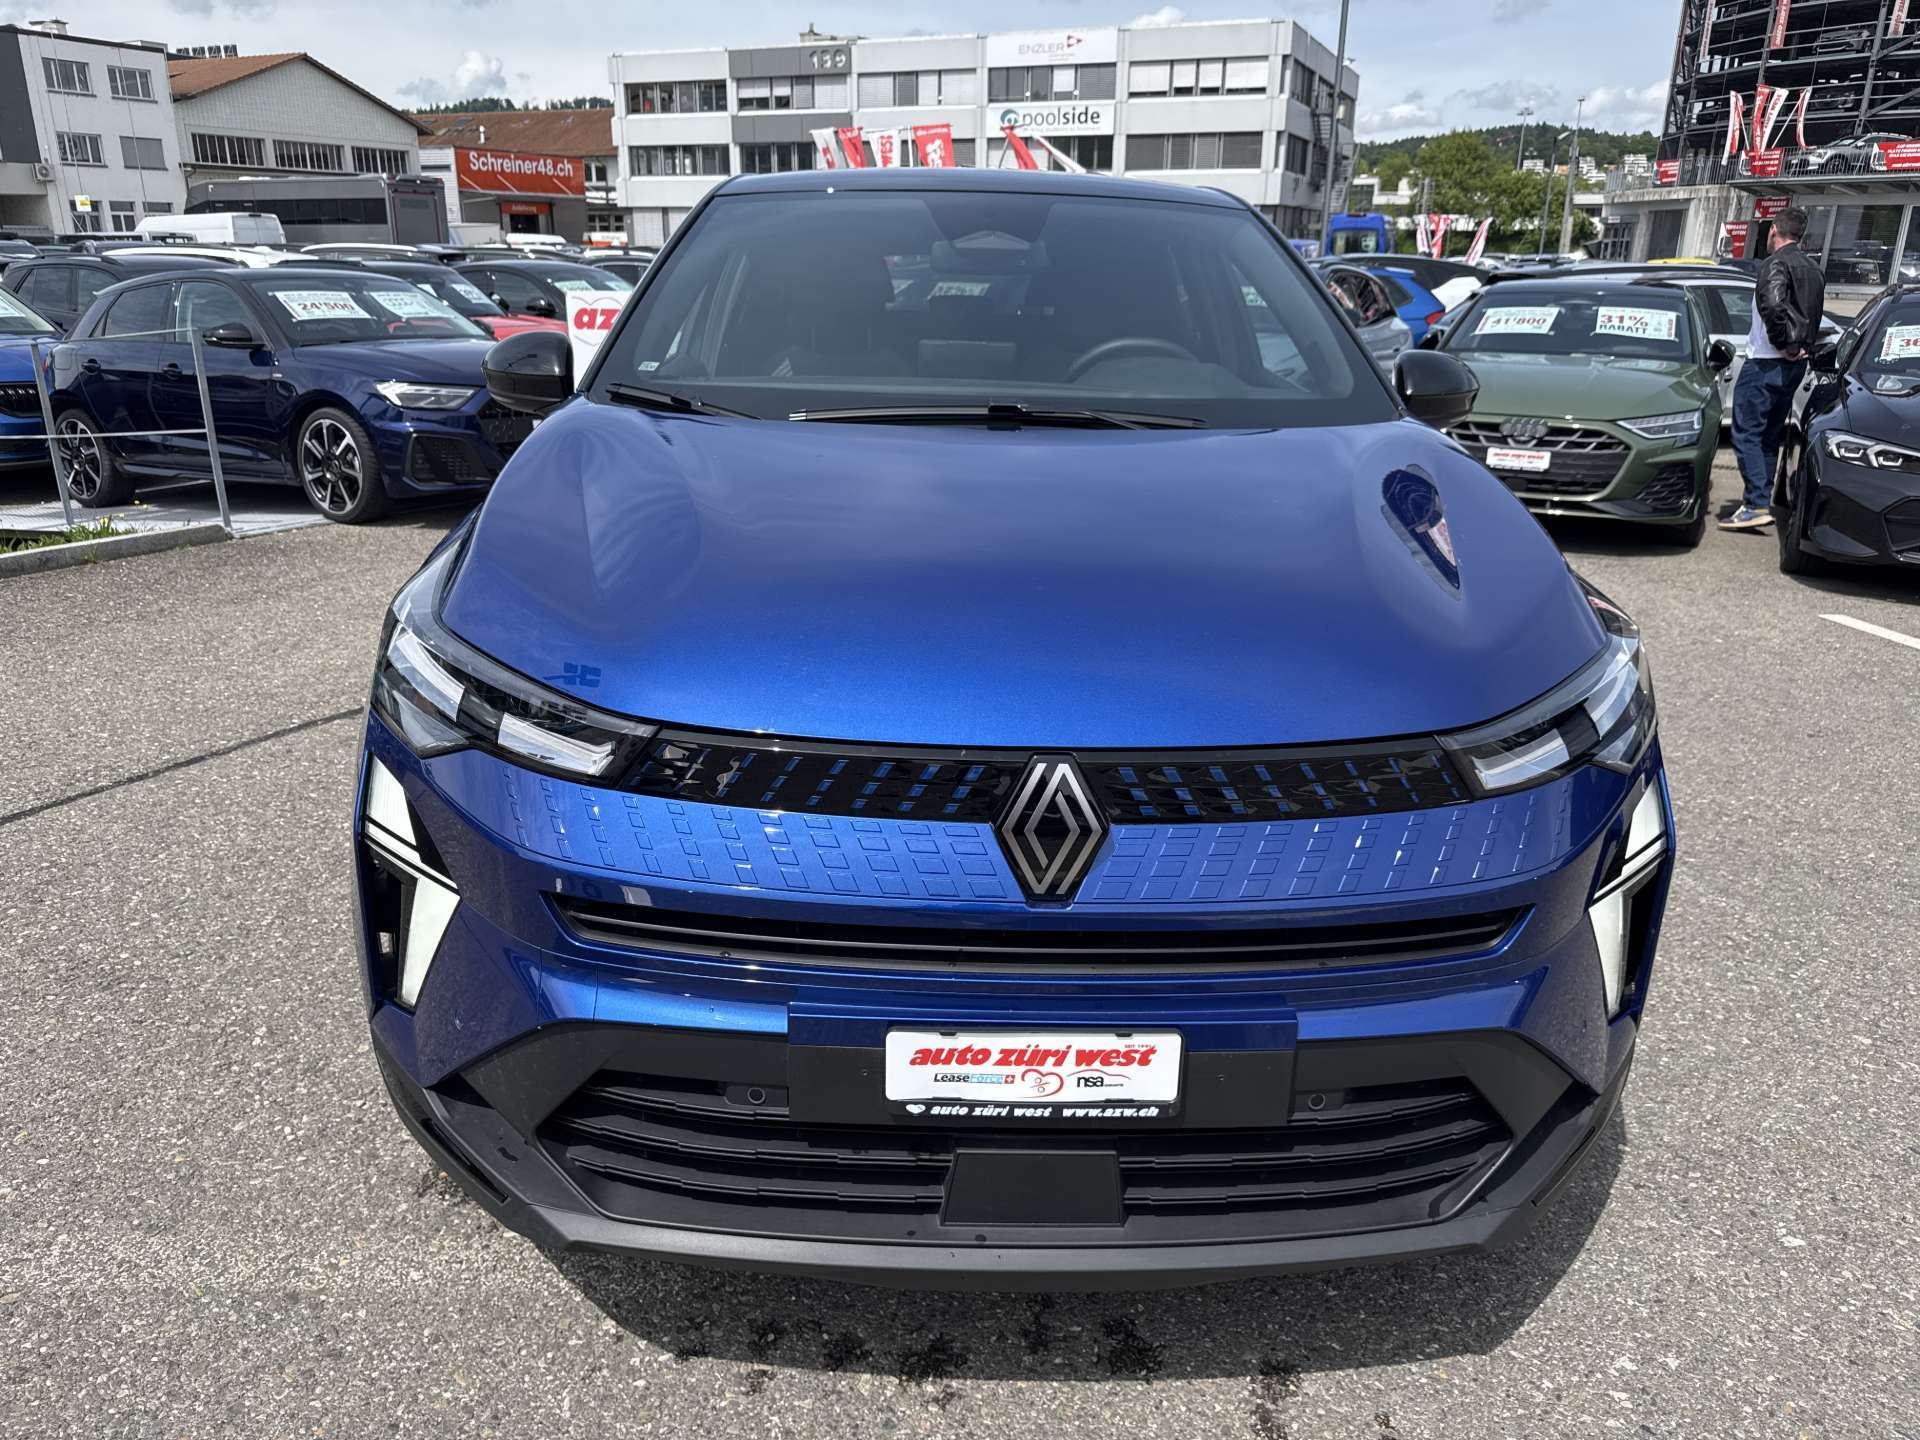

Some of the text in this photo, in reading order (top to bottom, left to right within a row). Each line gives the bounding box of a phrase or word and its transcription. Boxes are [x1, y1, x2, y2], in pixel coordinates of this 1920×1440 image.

[1018, 42, 1065, 56] ENZLER
[1022, 105, 1101, 127] poolside
[469, 151, 573, 177] Schreiner48.ch
[1599, 324, 1648, 335] RABATT
[909, 1044, 1157, 1067] auto züri west
[1076, 1076, 1104, 1088] nsa
[930, 1104, 1160, 1117] auto züri west www.azw.ch
